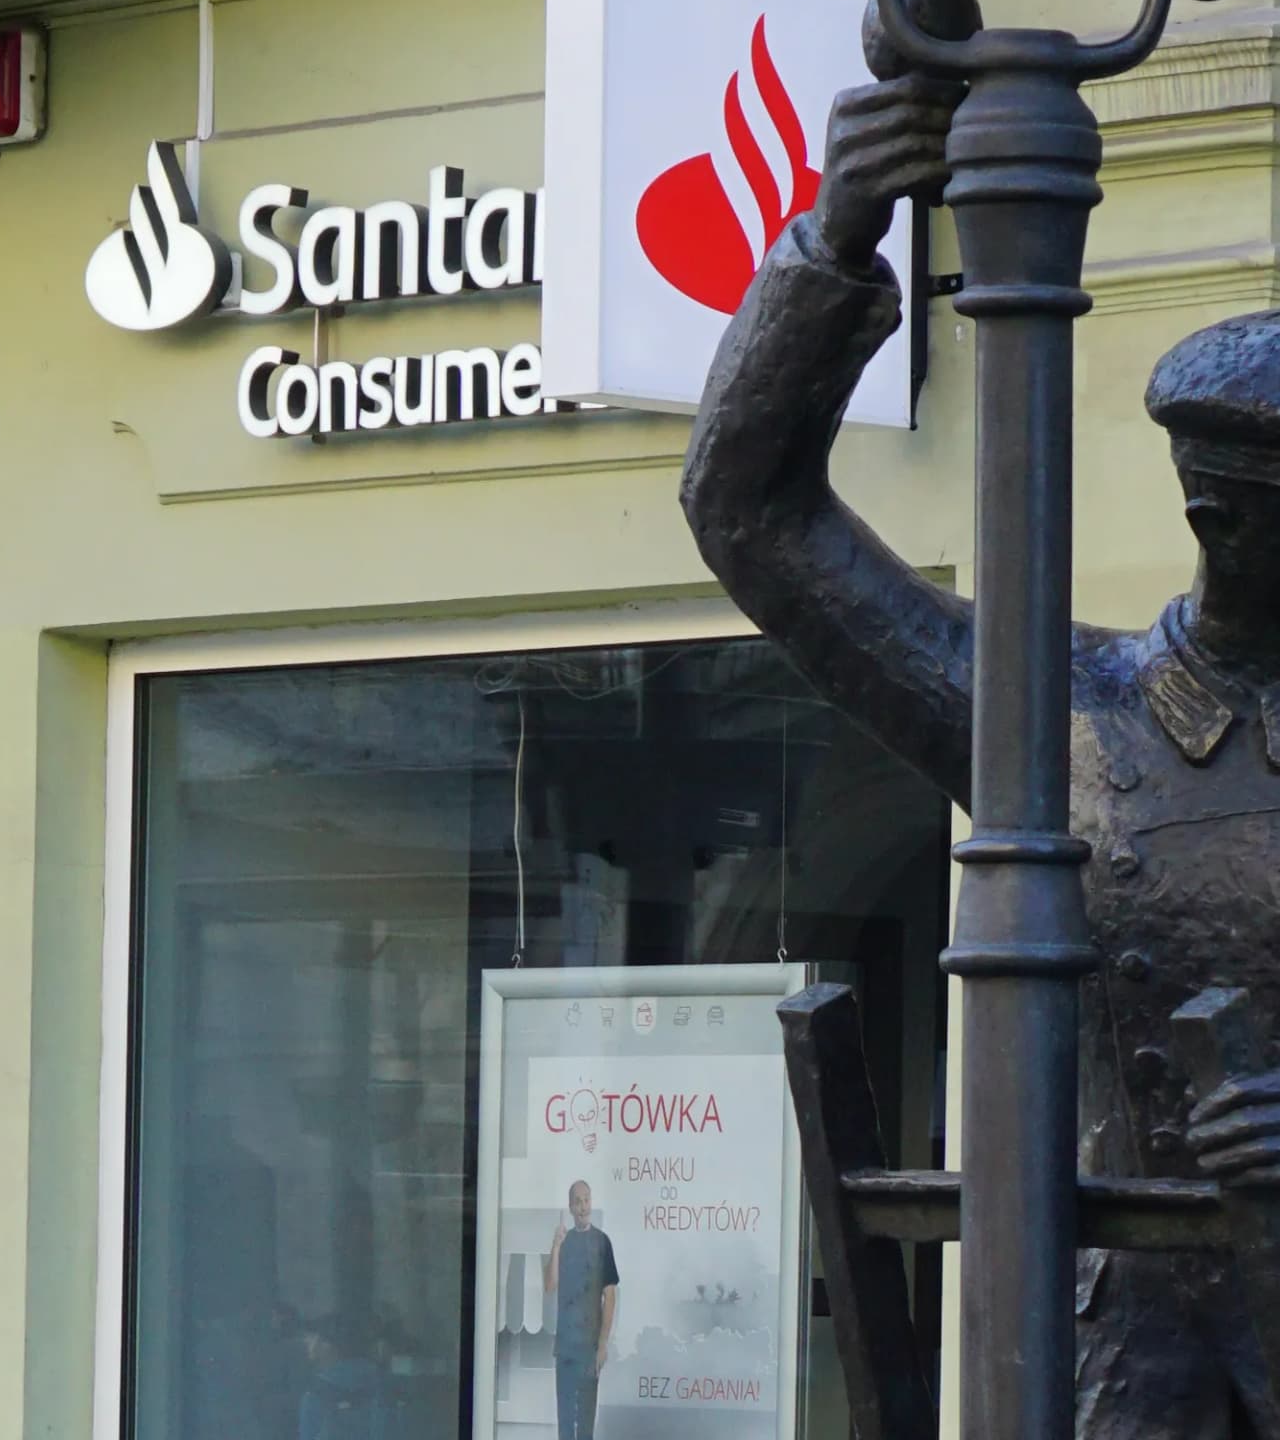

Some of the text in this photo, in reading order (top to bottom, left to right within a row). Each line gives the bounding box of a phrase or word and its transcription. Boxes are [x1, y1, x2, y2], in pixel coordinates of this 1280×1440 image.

[239, 164, 545, 314] Santa
[237, 343, 544, 437] Consume
[628, 1156, 696, 1182] BANKU
[643, 1199, 761, 1232] KREDYTÓW?
[638, 1375, 761, 1402] BEZ GADANIA!
